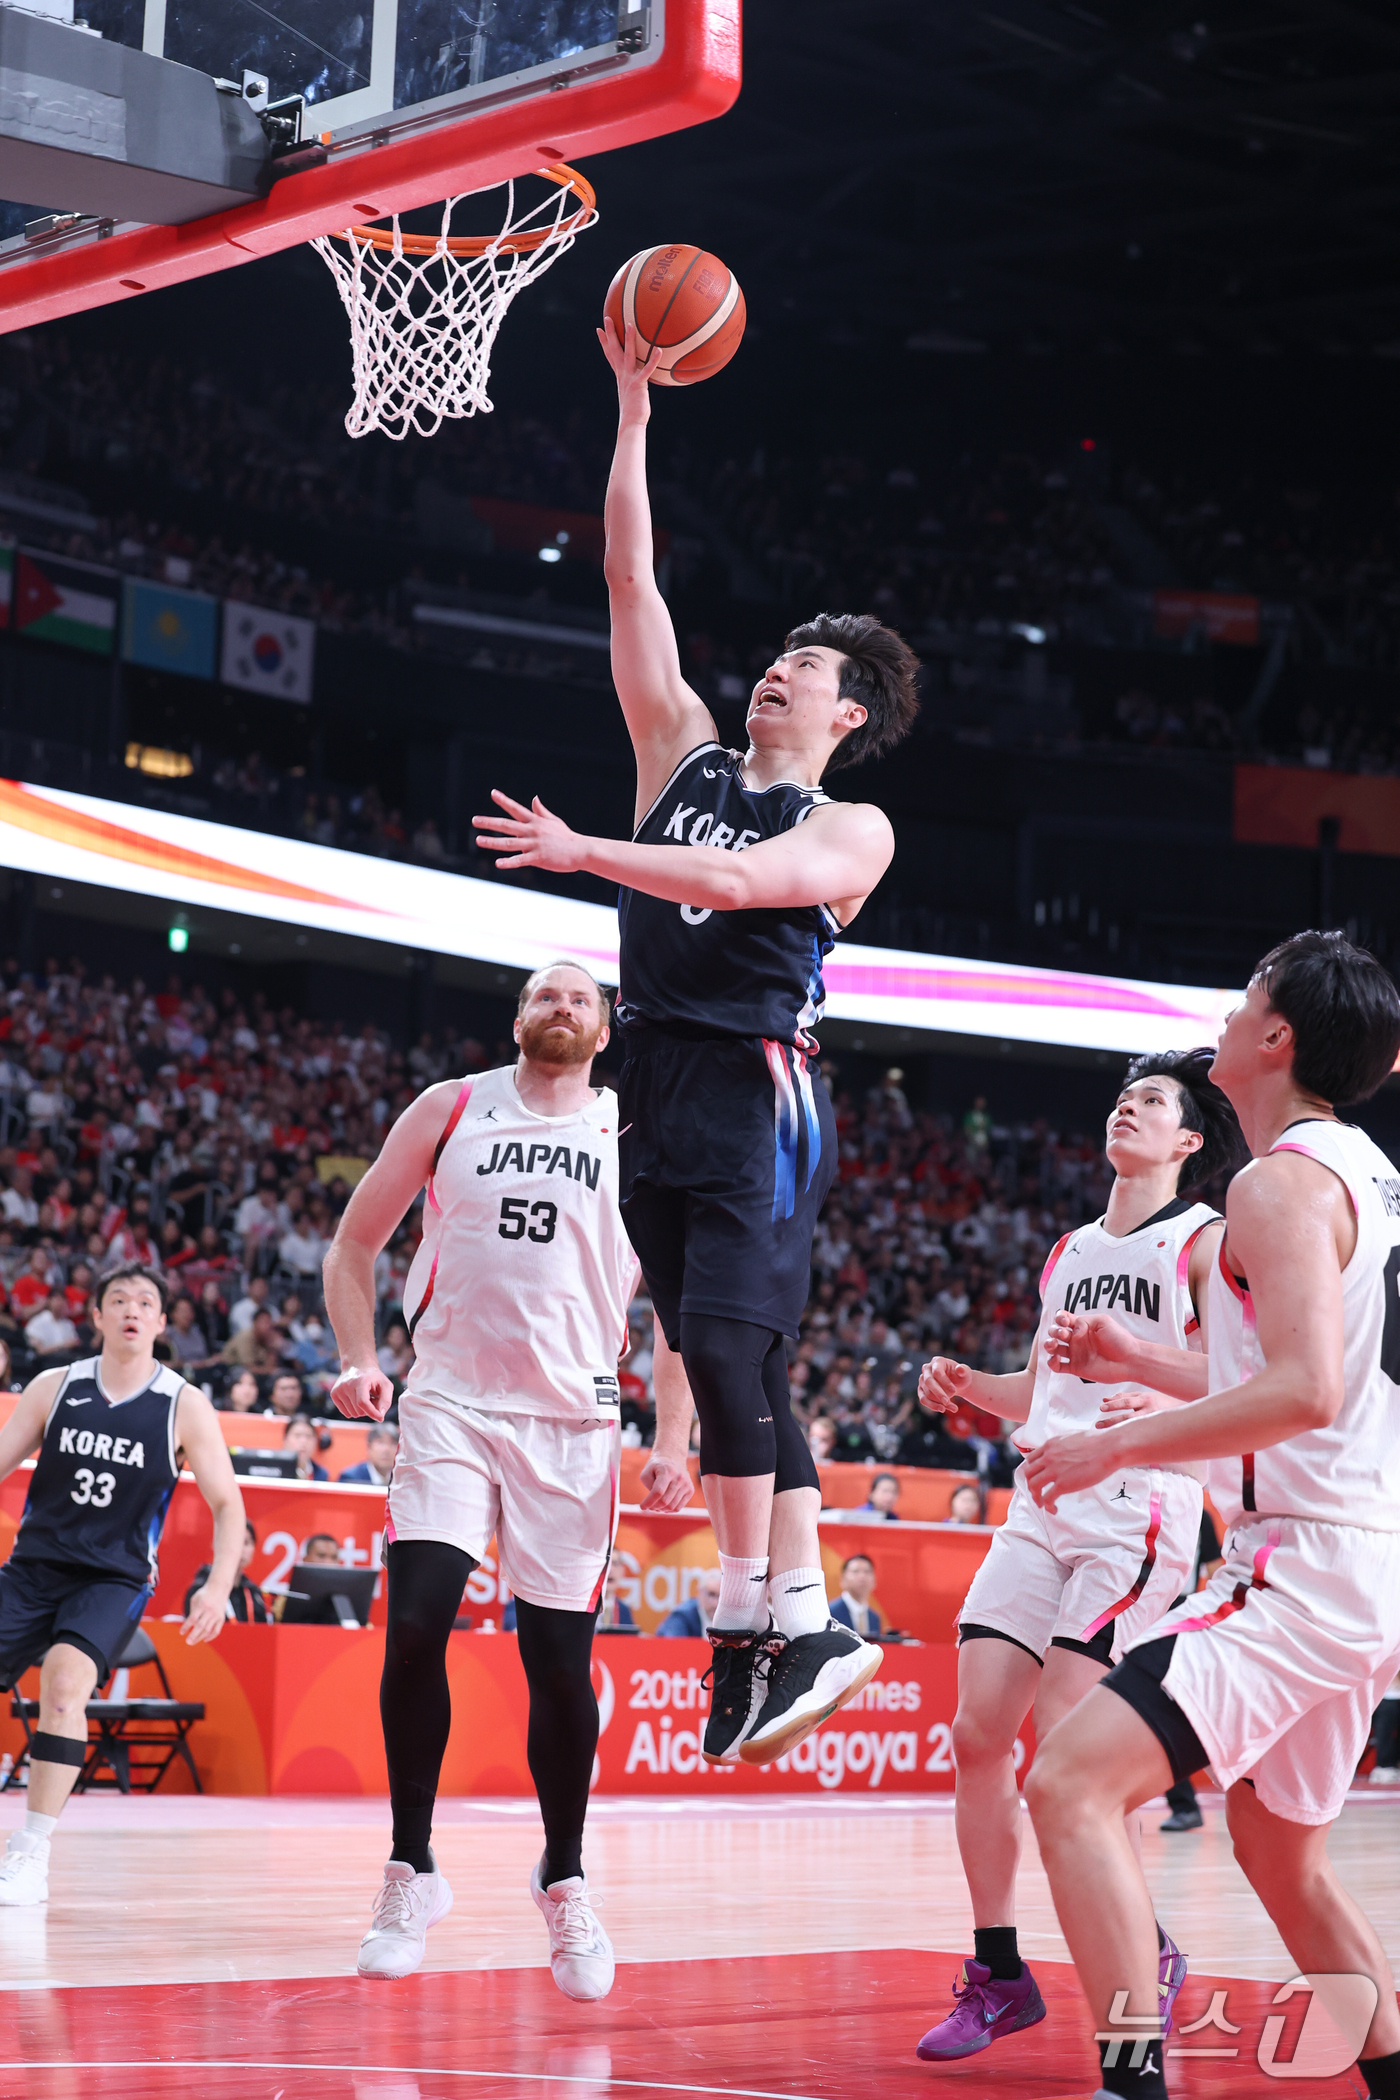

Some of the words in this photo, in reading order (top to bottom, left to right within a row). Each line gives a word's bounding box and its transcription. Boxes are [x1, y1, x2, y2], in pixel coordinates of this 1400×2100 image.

[649, 247, 682, 292] molten
[693, 268, 716, 295] FIBA
[663, 802, 761, 852] KORE
[477, 1142, 601, 1192] JAPAN
[498, 1197, 558, 1243] 53
[59, 1427, 145, 1469] KOREA
[70, 1467, 117, 1508] 33
[628, 1668, 709, 1710] 20th
